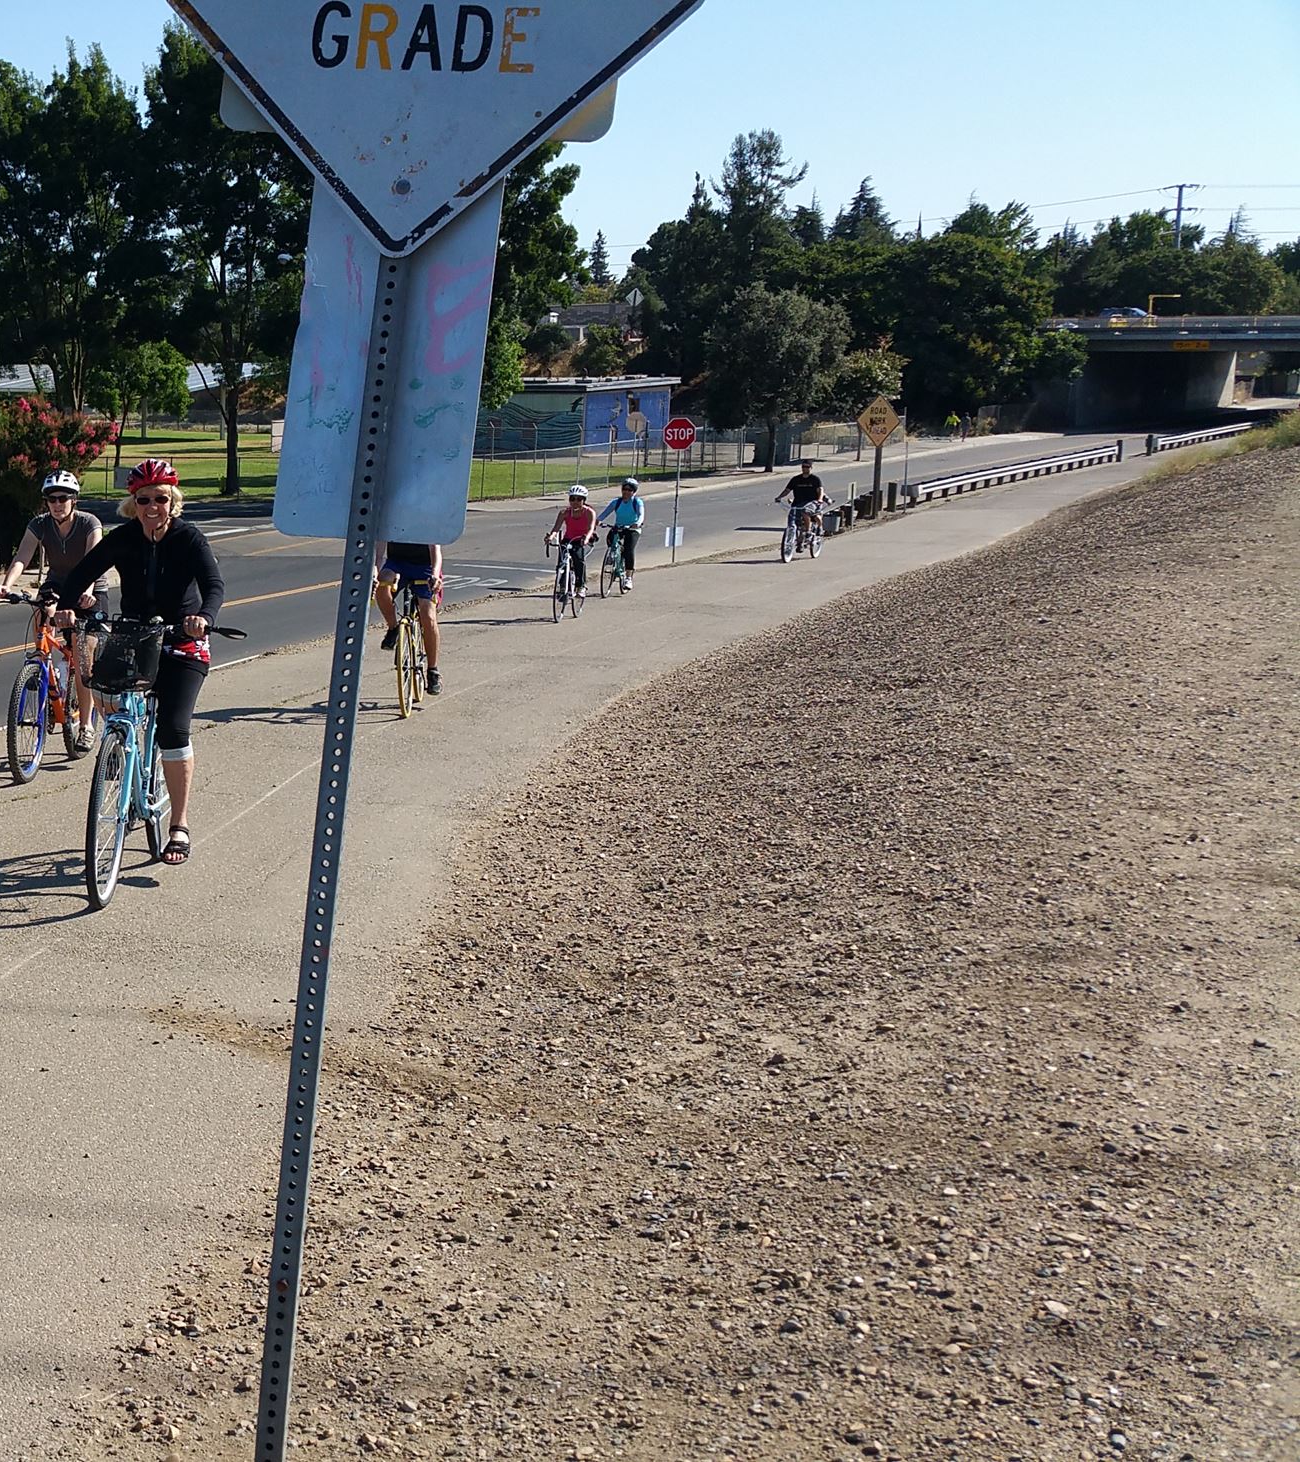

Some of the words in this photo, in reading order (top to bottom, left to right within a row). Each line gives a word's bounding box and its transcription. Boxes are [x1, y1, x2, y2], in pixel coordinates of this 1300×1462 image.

[312, 0, 541, 73] GRADE
[870, 406, 888, 415] ROAD
[665, 428, 694, 441] STOP
